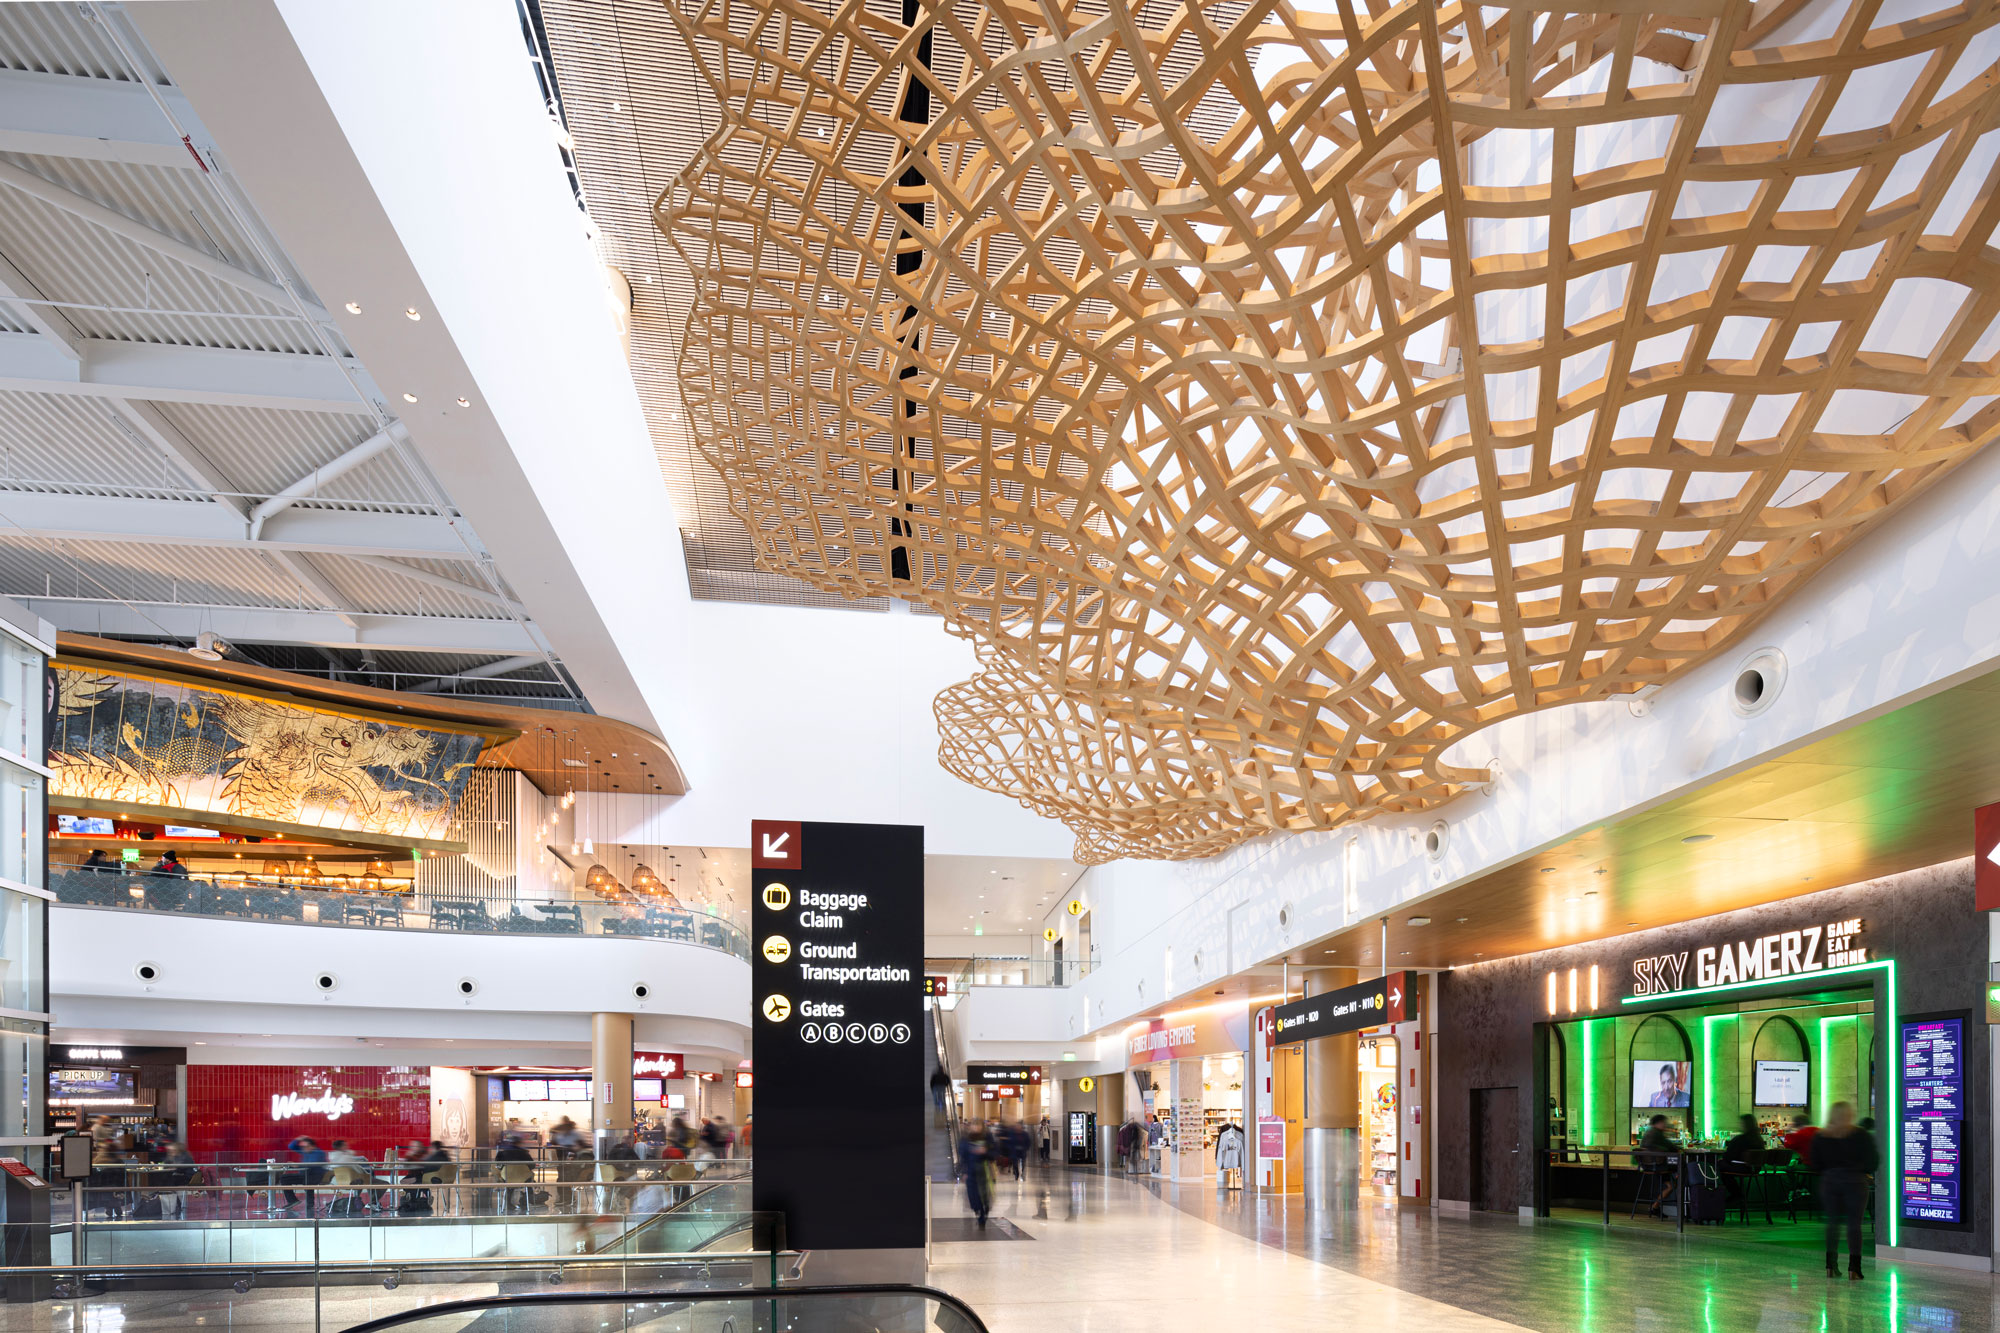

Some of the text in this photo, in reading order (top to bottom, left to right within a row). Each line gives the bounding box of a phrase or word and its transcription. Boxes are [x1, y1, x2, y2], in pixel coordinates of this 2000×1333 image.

[799, 889, 867, 911] Baggage
[799, 911, 843, 929] Claim
[1827, 918, 1862, 938] GAME
[799, 941, 857, 959] Ground
[1827, 935, 1851, 953] EAT
[1633, 926, 1823, 996] SKY GAMERZ
[1827, 948, 1867, 968] DRINK
[799, 963, 910, 984] Transportation
[799, 1000, 845, 1018] Gates
[1333, 1005, 1349, 1017] Gates
[1349, 1001, 1357, 1013] N1
[1362, 996, 1374, 1010] N10
[1283, 1018, 1296, 1028] Gates
[1296, 1014, 1305, 1026] N11
[1308, 1010, 1319, 1022] N20
[1169, 1024, 1197, 1047] EMPIRE
[64, 1071, 104, 1080] PICK UP
[983, 1071, 998, 1079] Gates
[982, 1092, 994, 1100] N19
[1000, 1087, 1014, 1096] N20
[272, 1087, 354, 1121] Wendy's
[1920, 1208, 1946, 1219] GAMERZ
